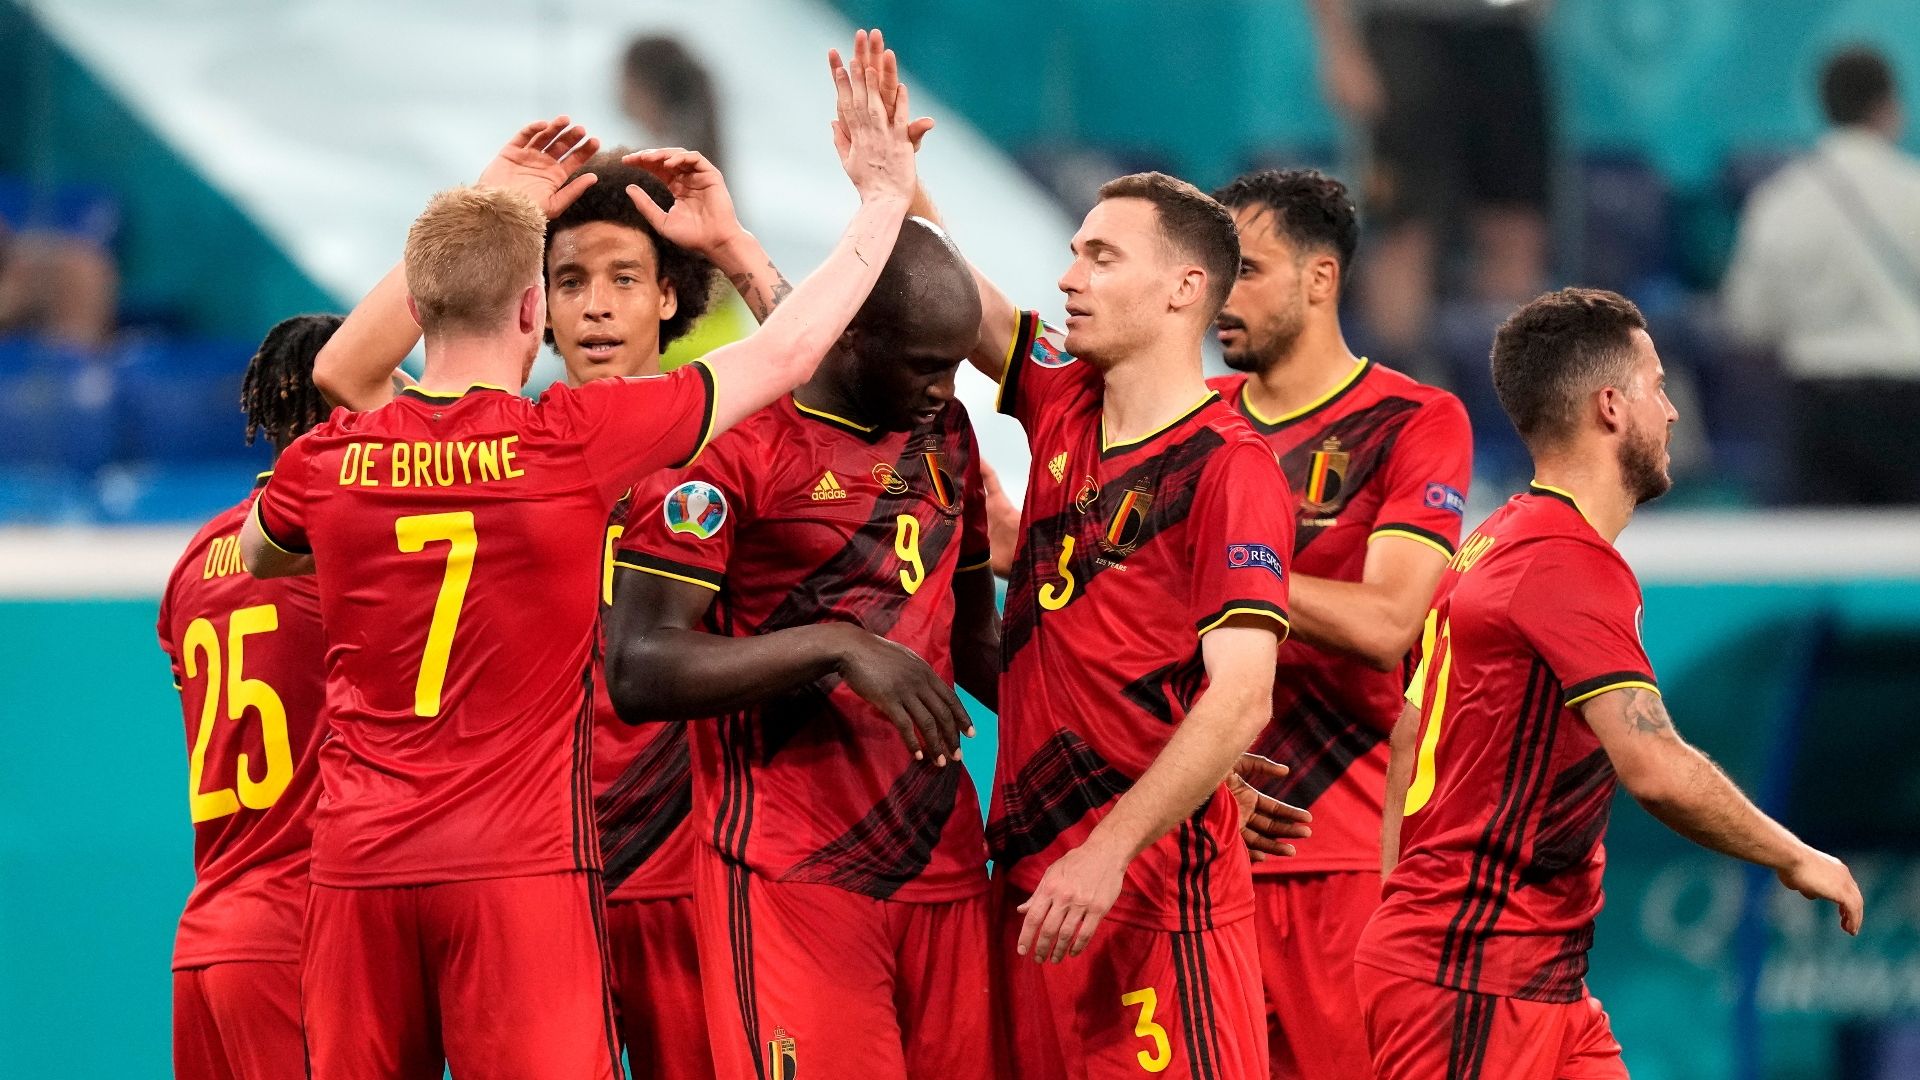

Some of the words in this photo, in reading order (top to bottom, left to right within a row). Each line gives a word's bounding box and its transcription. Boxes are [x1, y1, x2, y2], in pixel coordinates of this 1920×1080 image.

[340, 443, 383, 486] DE
[392, 435, 525, 487] BRUYNE
[811, 489, 847, 500] adidas
[203, 535, 249, 580] DOK
[894, 514, 925, 595] 9
[1038, 534, 1076, 611] 3
[1095, 557, 1107, 566] 125
[1107, 561, 1128, 572] YEARS
[1251, 550, 1282, 576] RESPECT
[395, 511, 478, 717] 7
[183, 604, 293, 823] 25
[1122, 987, 1171, 1073] 3
